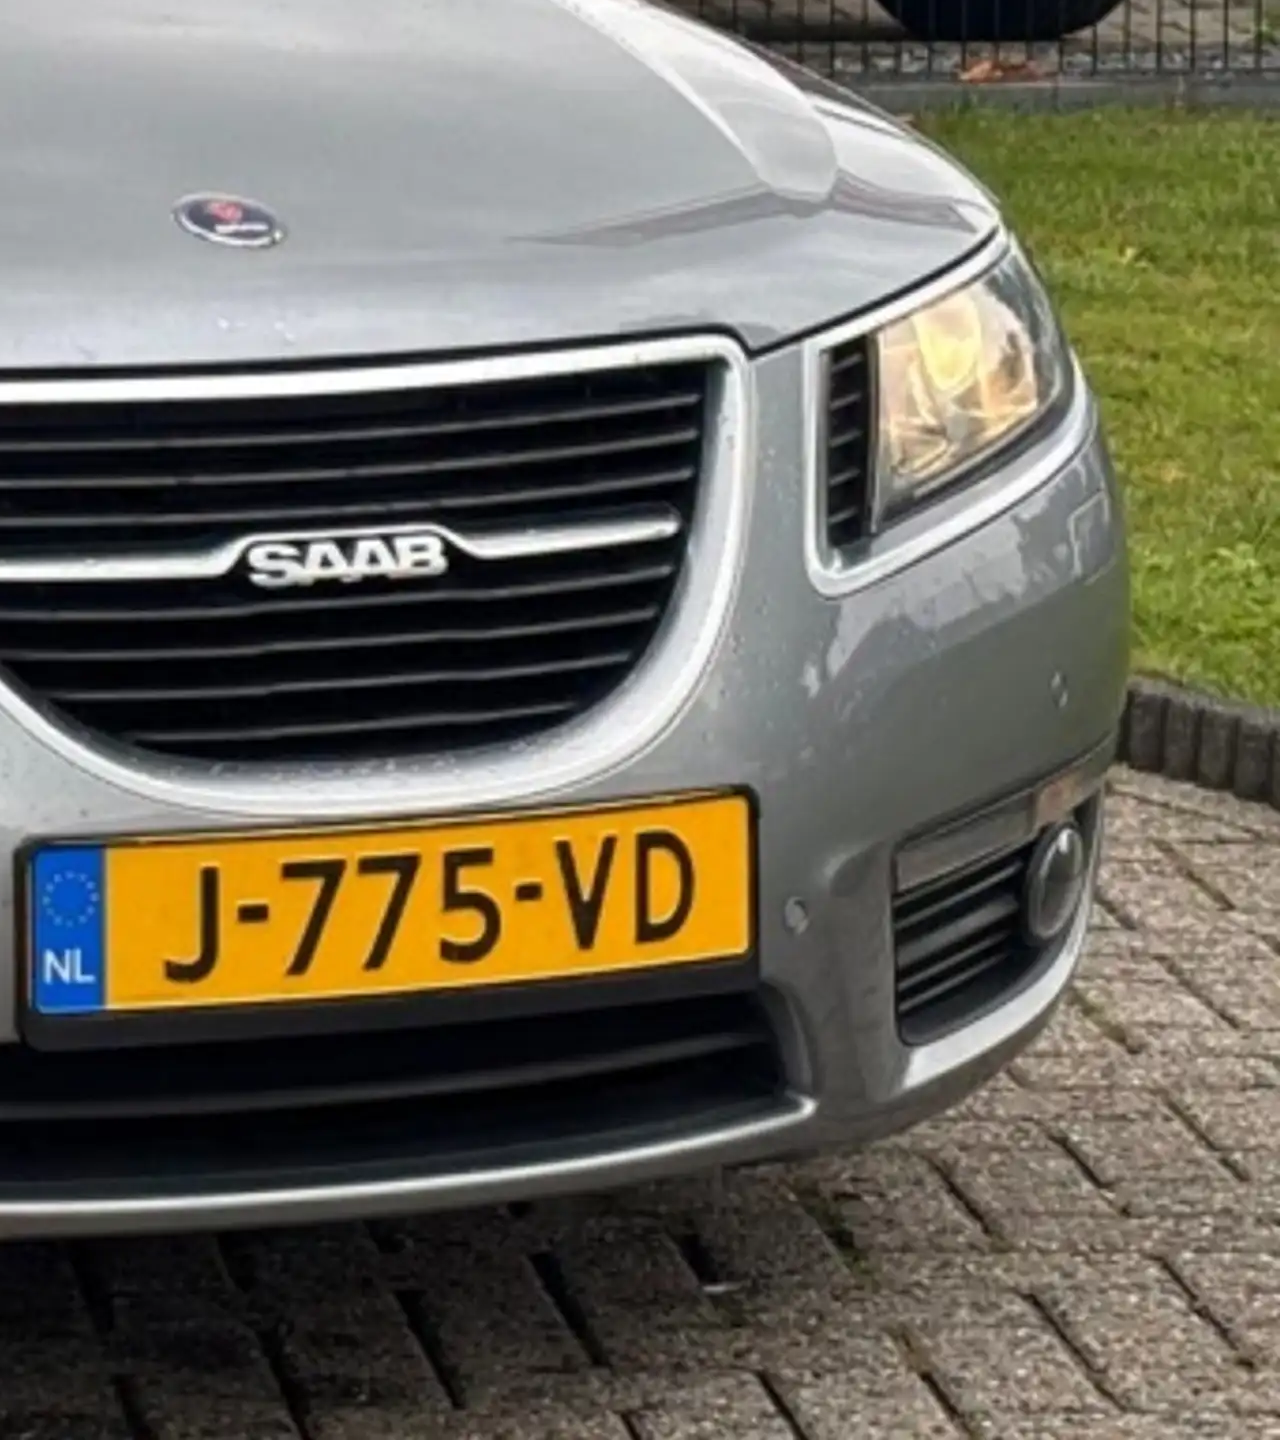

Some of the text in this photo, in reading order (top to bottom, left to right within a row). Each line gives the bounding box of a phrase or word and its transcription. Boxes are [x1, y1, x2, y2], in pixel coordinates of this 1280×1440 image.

[247, 535, 449, 588] SAAB
[163, 829, 696, 985] J-775-VD
[43, 949, 96, 985] NL
